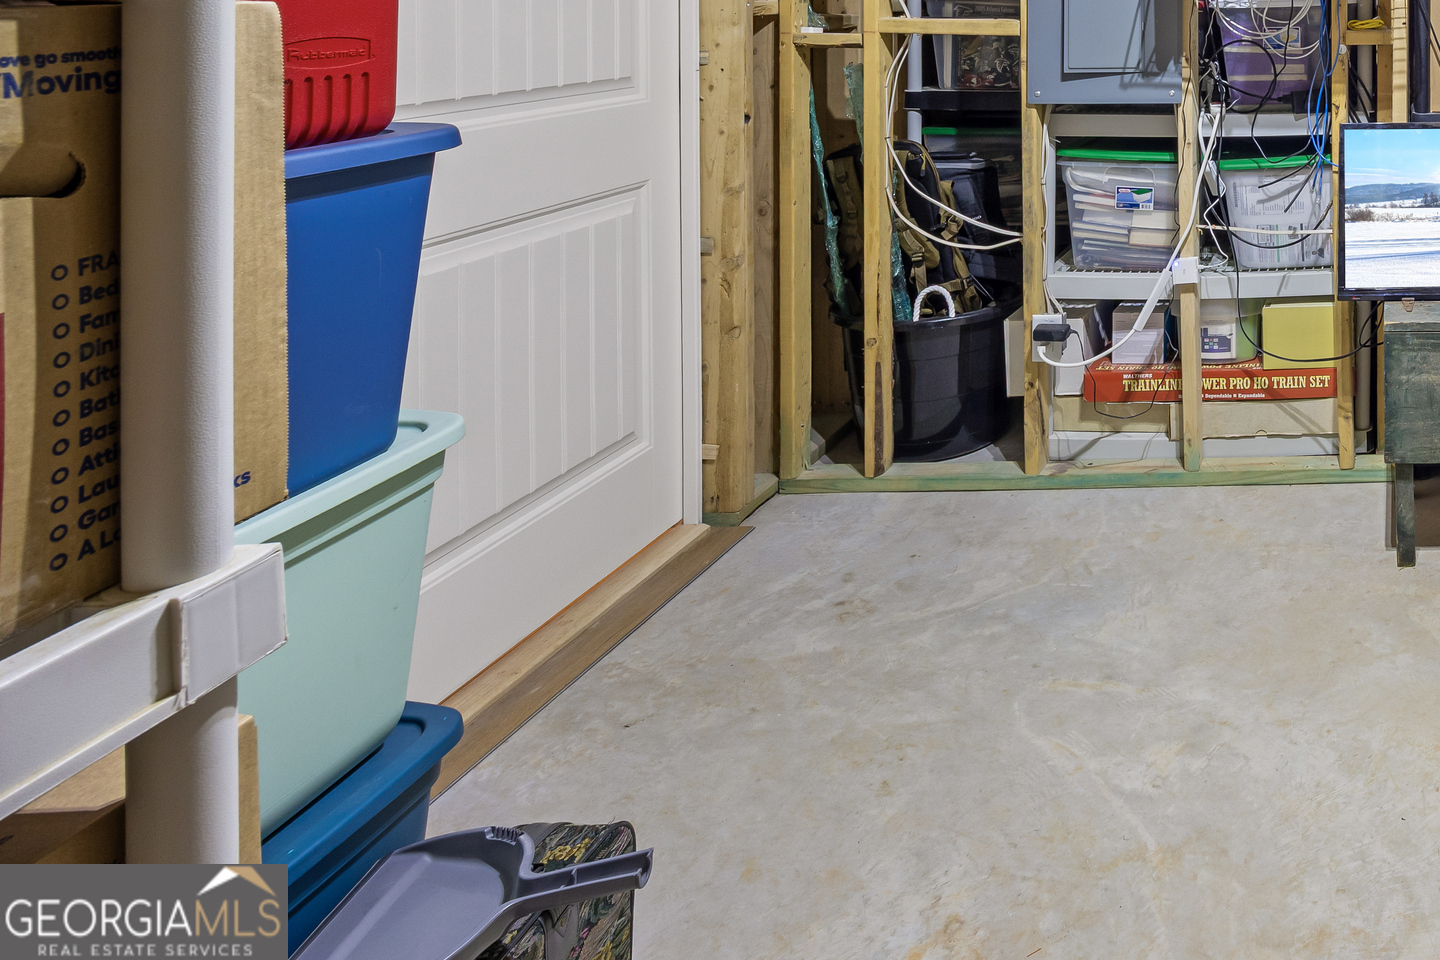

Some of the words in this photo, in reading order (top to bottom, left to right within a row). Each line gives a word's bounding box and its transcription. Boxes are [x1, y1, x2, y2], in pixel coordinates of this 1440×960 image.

[0, 55, 31, 67] ove
[34, 53, 57, 68] go
[61, 46, 121, 63] smooth
[287, 46, 366, 61] Rubbermaid
[2, 66, 121, 99] Moving
[78, 250, 120, 276] FRA
[79, 278, 120, 304] Bed
[80, 309, 120, 333] Fam
[80, 335, 120, 362] Dini
[80, 364, 120, 390] Kitc
[1201, 378, 1227, 391] WER
[1229, 377, 1250, 390] PRO
[1253, 376, 1269, 389] HO
[1272, 376, 1307, 389] TRAIN
[1309, 375, 1330, 388] SET
[79, 420, 120, 447] Bas
[78, 443, 120, 476] Atti
[78, 475, 120, 504] Lau
[78, 503, 120, 530] Gar
[77, 539, 96, 561] A
